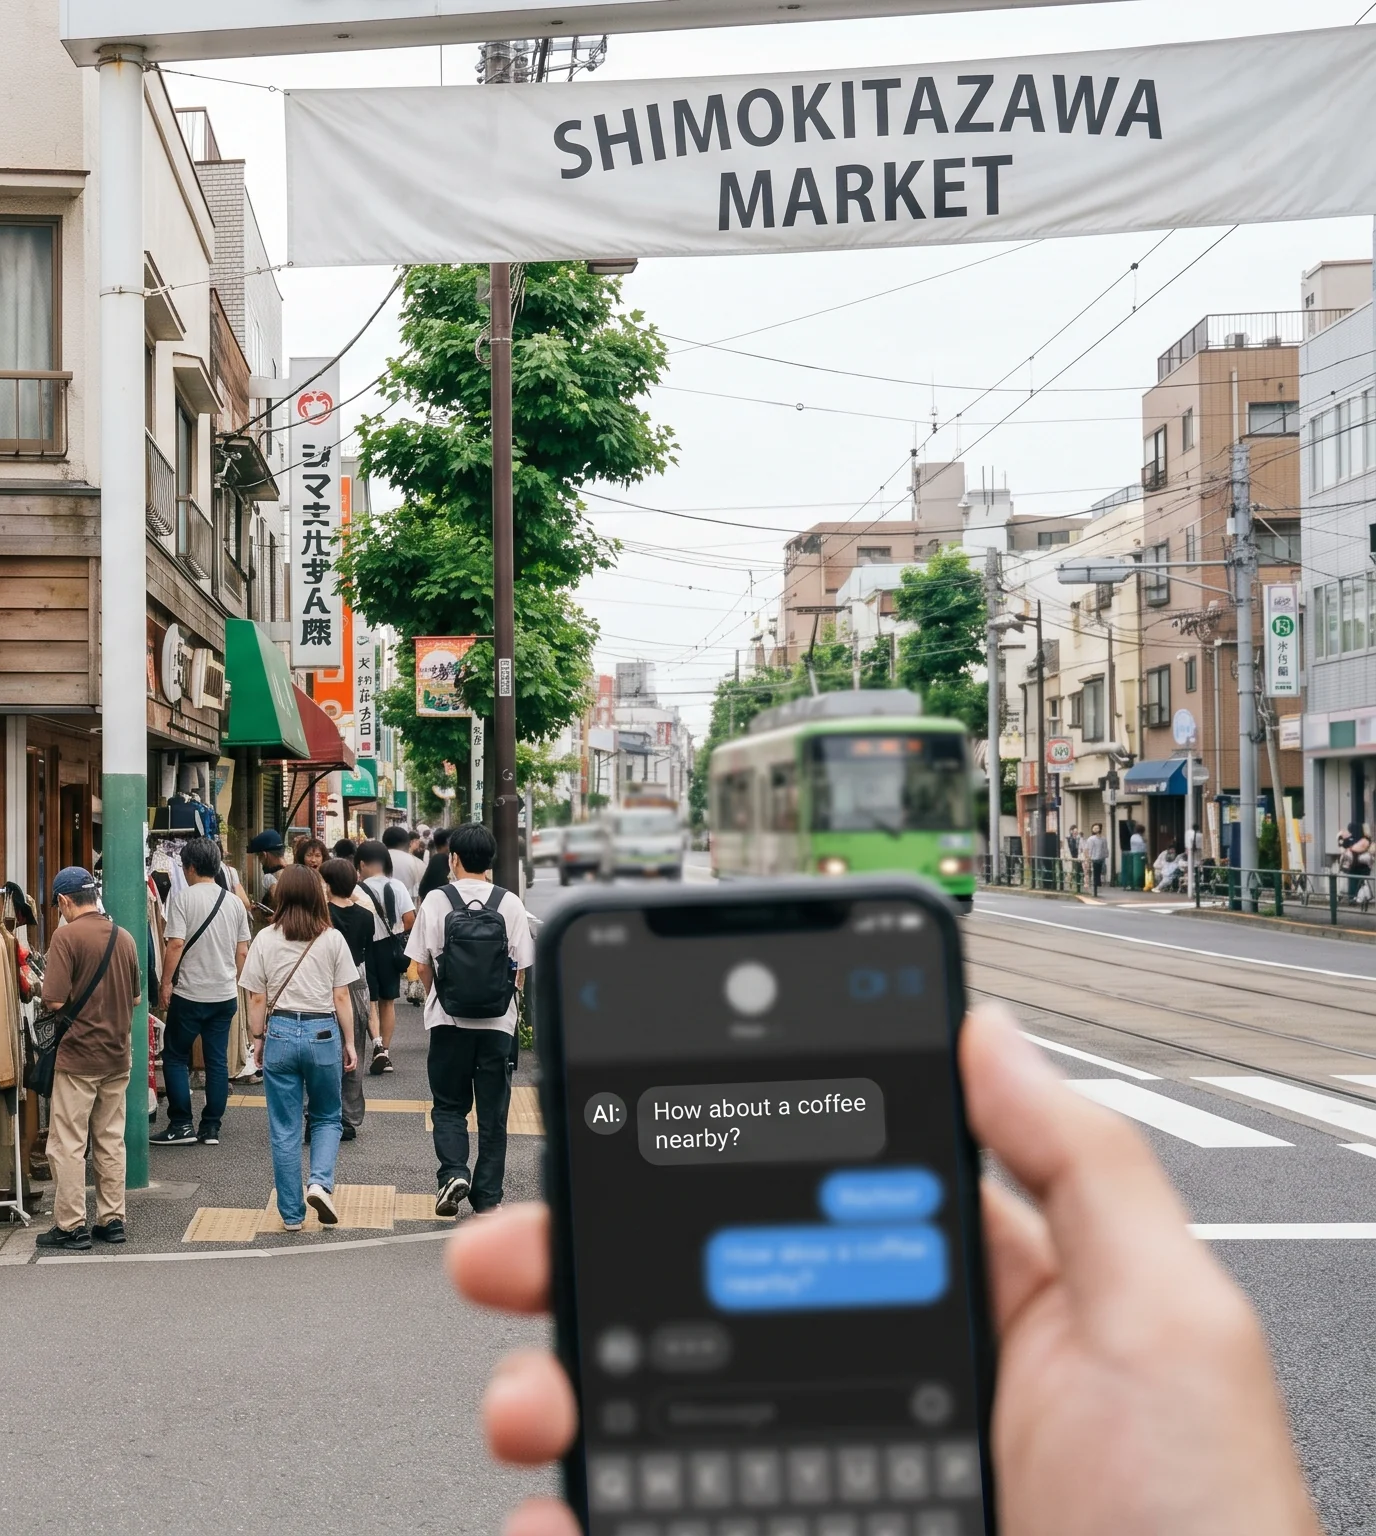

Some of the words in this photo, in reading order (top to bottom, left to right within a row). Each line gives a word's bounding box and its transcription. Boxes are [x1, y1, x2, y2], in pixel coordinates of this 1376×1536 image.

[552, 74, 1164, 181] SHIMOKITAZAWA
[718, 154, 1014, 232] MARKET
[592, 1103, 621, 1124] AI:
[654, 1101, 702, 1121] How
[709, 1098, 772, 1119] about
[778, 1100, 791, 1115] a
[797, 1093, 866, 1115] coffee
[656, 1127, 741, 1152] nearby?
